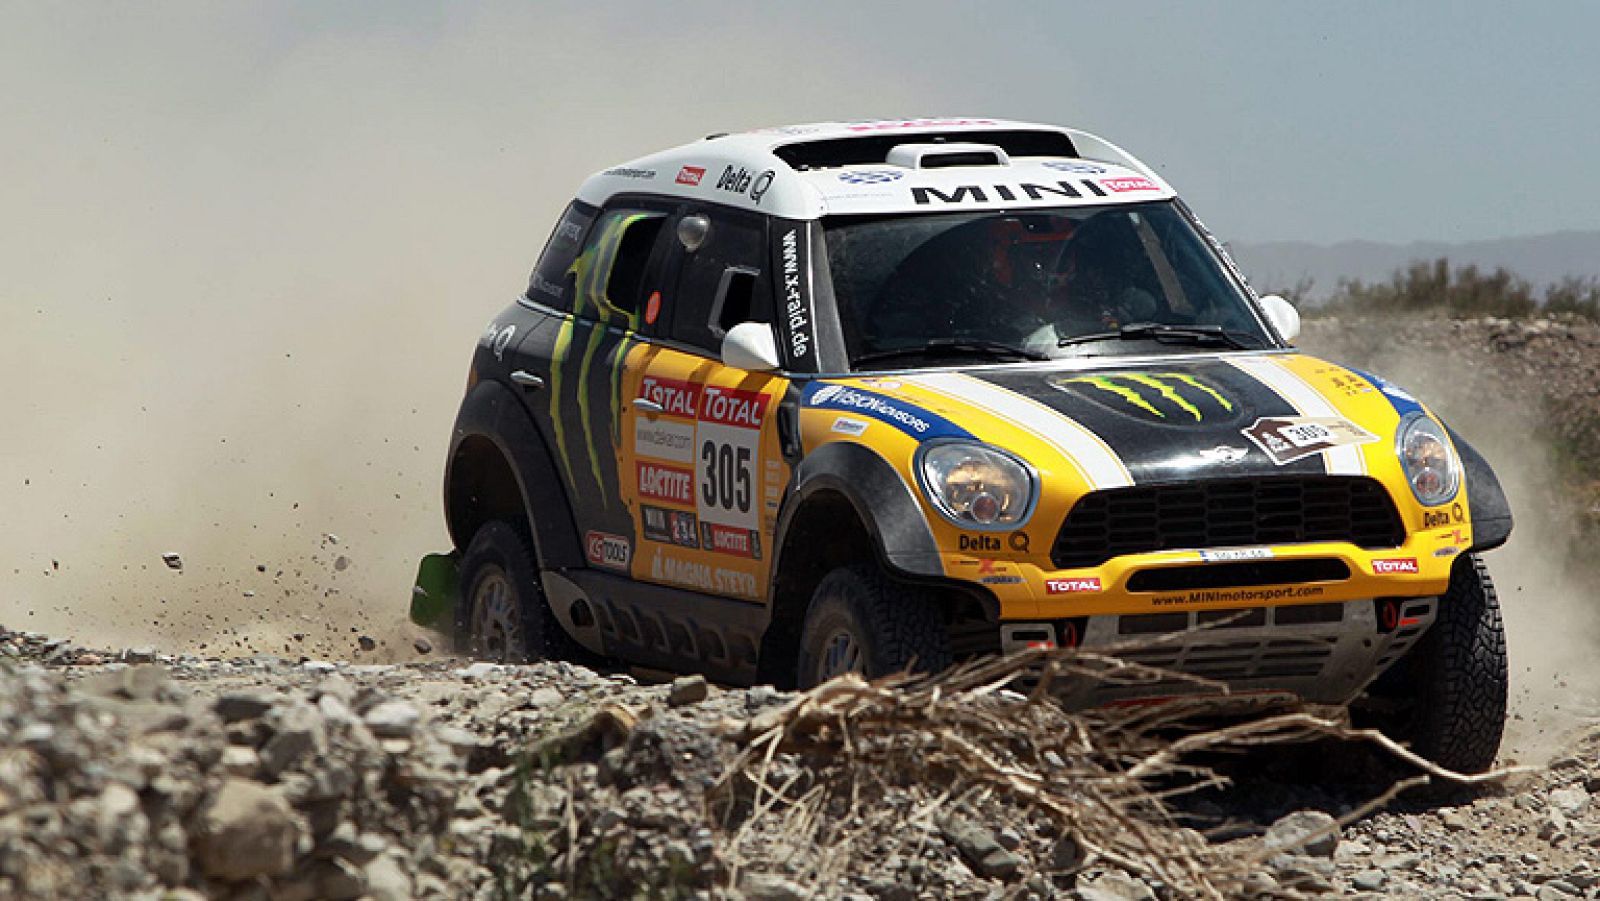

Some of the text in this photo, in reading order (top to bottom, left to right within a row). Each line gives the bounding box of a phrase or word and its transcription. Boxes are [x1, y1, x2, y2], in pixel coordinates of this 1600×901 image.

[716, 164, 751, 194] Delta
[910, 178, 1108, 205] MINI
[1104, 179, 1158, 192] TOTAL
[782, 229, 809, 358] www.x-raid.de
[643, 378, 695, 415] TOTAL
[704, 387, 761, 426] TOTAL
[639, 465, 691, 501] LOCTITE
[701, 439, 751, 514] 305
[1423, 510, 1449, 528] Delta
[713, 529, 748, 553] LOCTITE
[958, 533, 1001, 551] Delta
[1371, 560, 1418, 573] TOTAL
[1047, 580, 1100, 592] TOTAL
[1151, 585, 1324, 606] www.MINImotorsport.com
